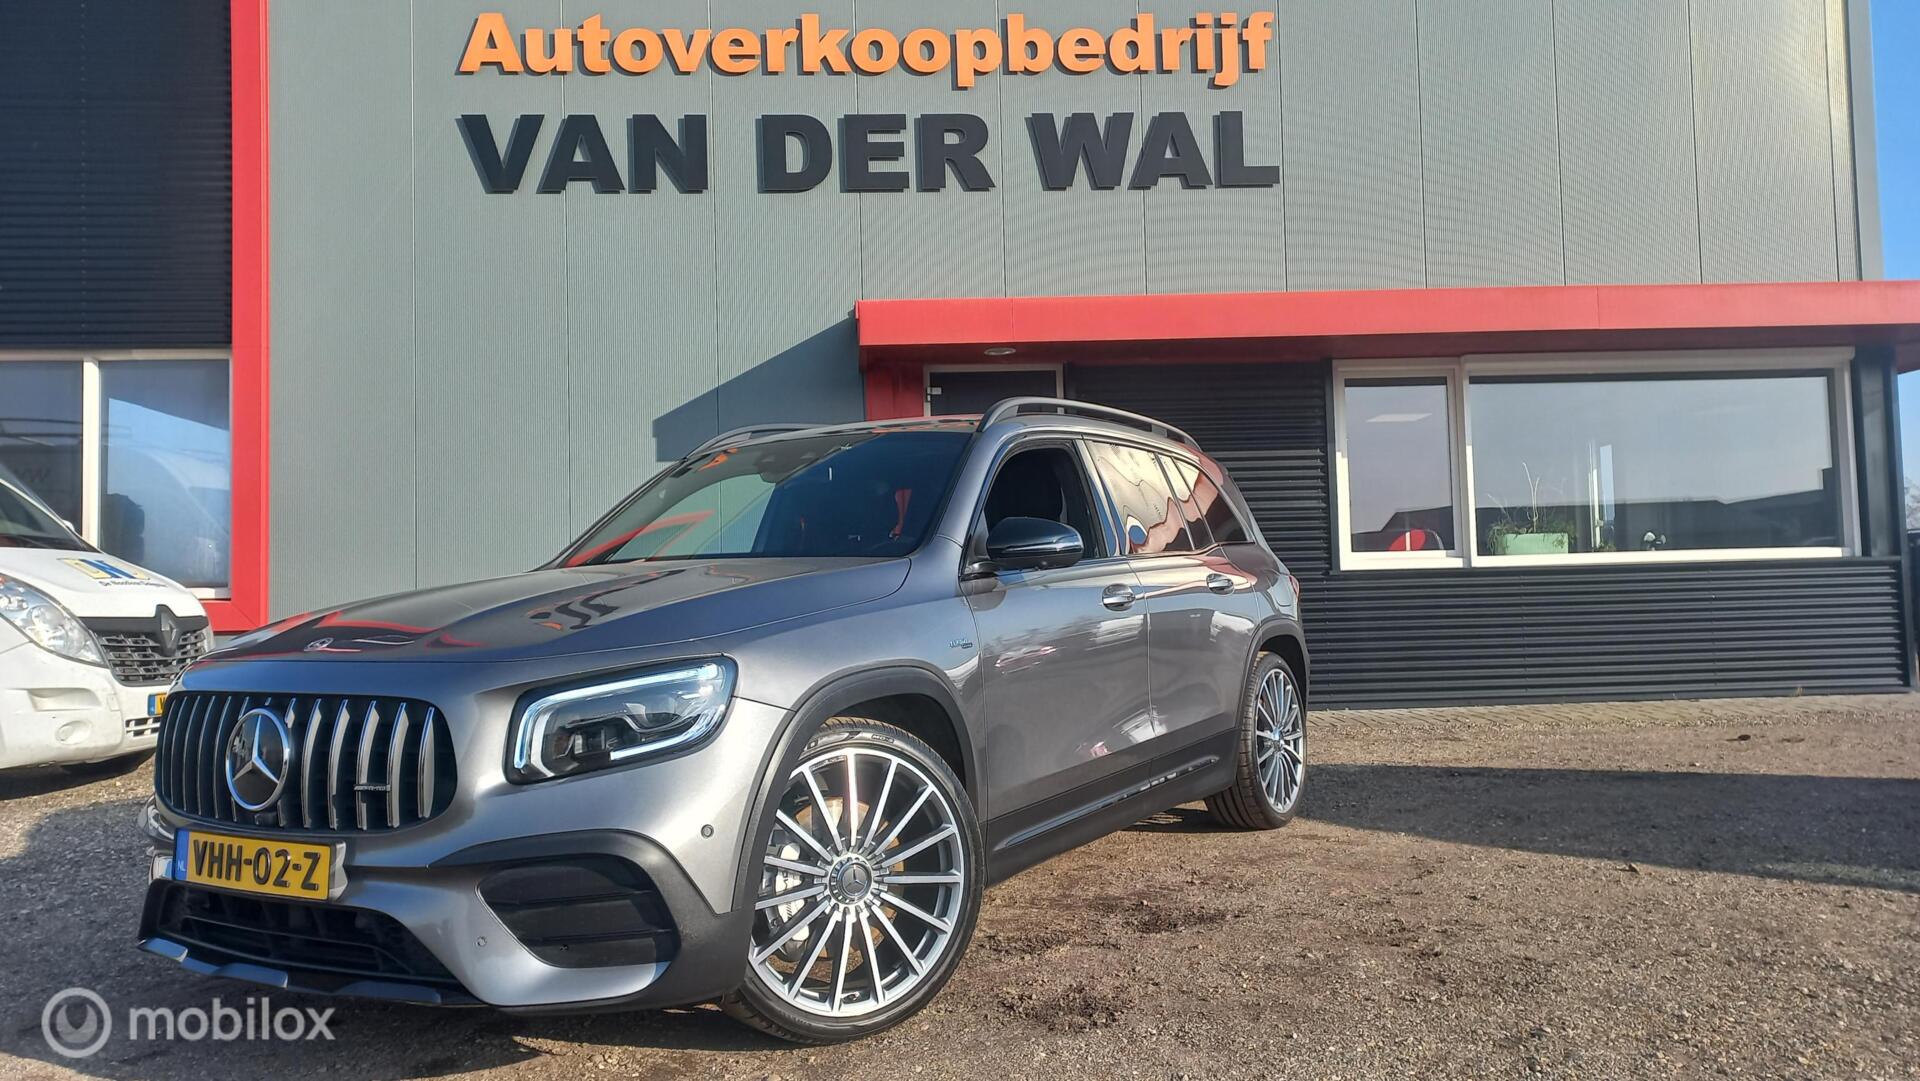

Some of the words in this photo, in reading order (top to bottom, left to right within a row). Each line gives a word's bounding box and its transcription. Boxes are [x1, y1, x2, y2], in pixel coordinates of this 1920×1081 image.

[461, 13, 1273, 87] Autoverkoopbedrijf
[460, 114, 708, 193] VAN
[758, 114, 995, 192] DER
[1029, 111, 1280, 191] WAL
[177, 860, 186, 872] NL
[193, 839, 321, 891] VHH-02-Z
